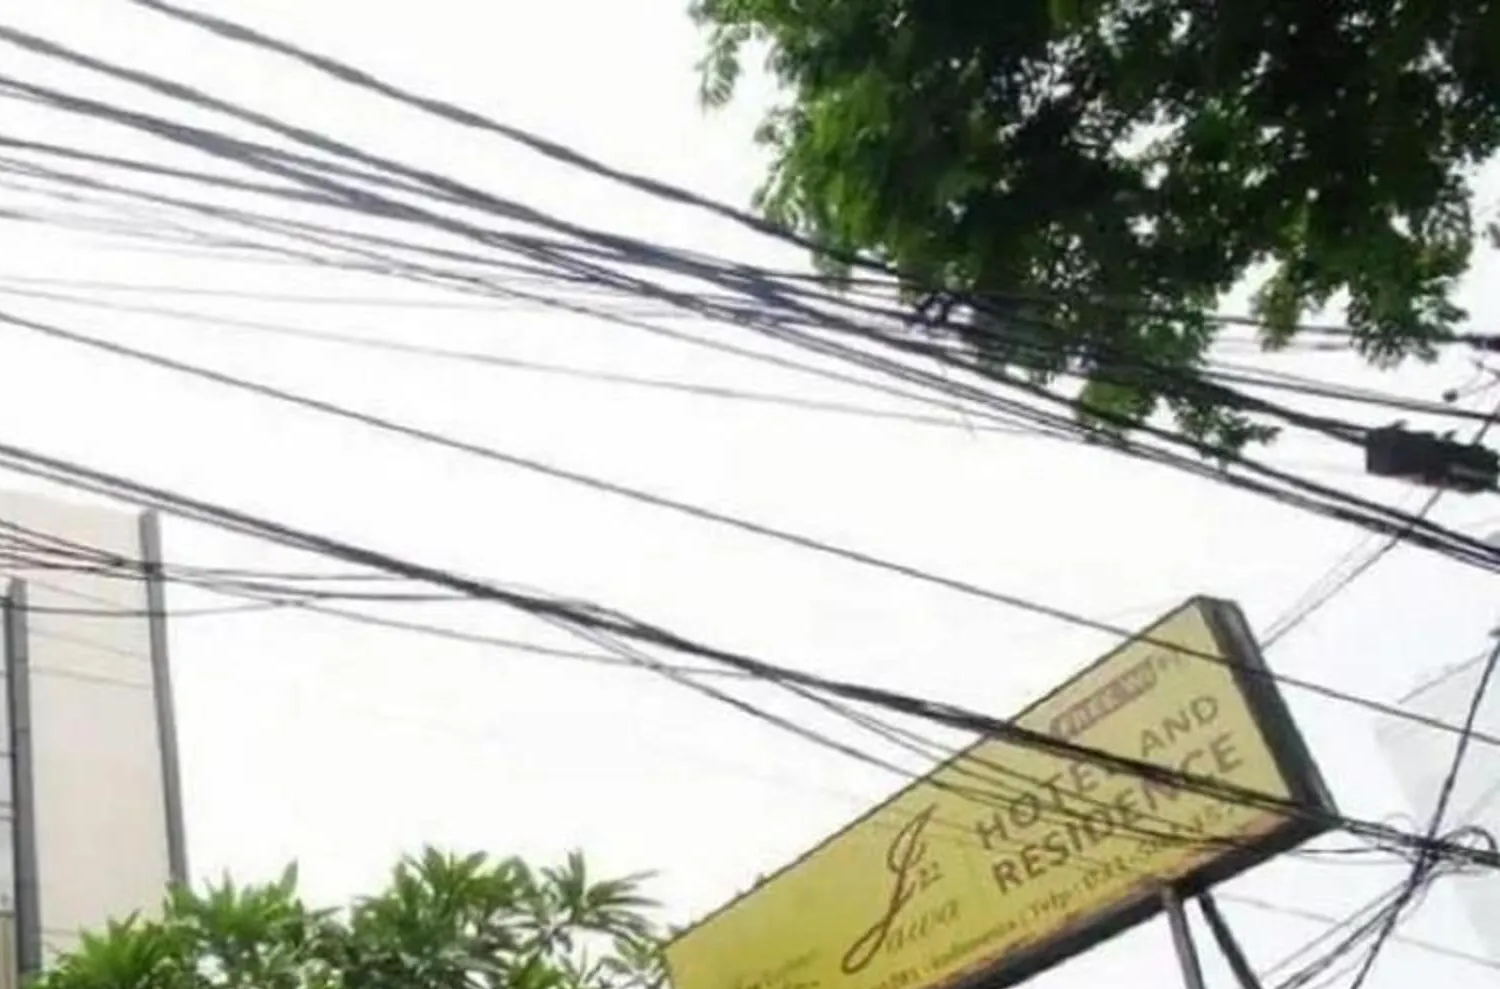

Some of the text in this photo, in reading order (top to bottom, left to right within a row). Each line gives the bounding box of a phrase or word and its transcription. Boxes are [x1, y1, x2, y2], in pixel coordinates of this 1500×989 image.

[974, 750, 1122, 850] HOTE
[1141, 695, 1219, 757] AND
[991, 731, 1244, 895] RESIDENCE
